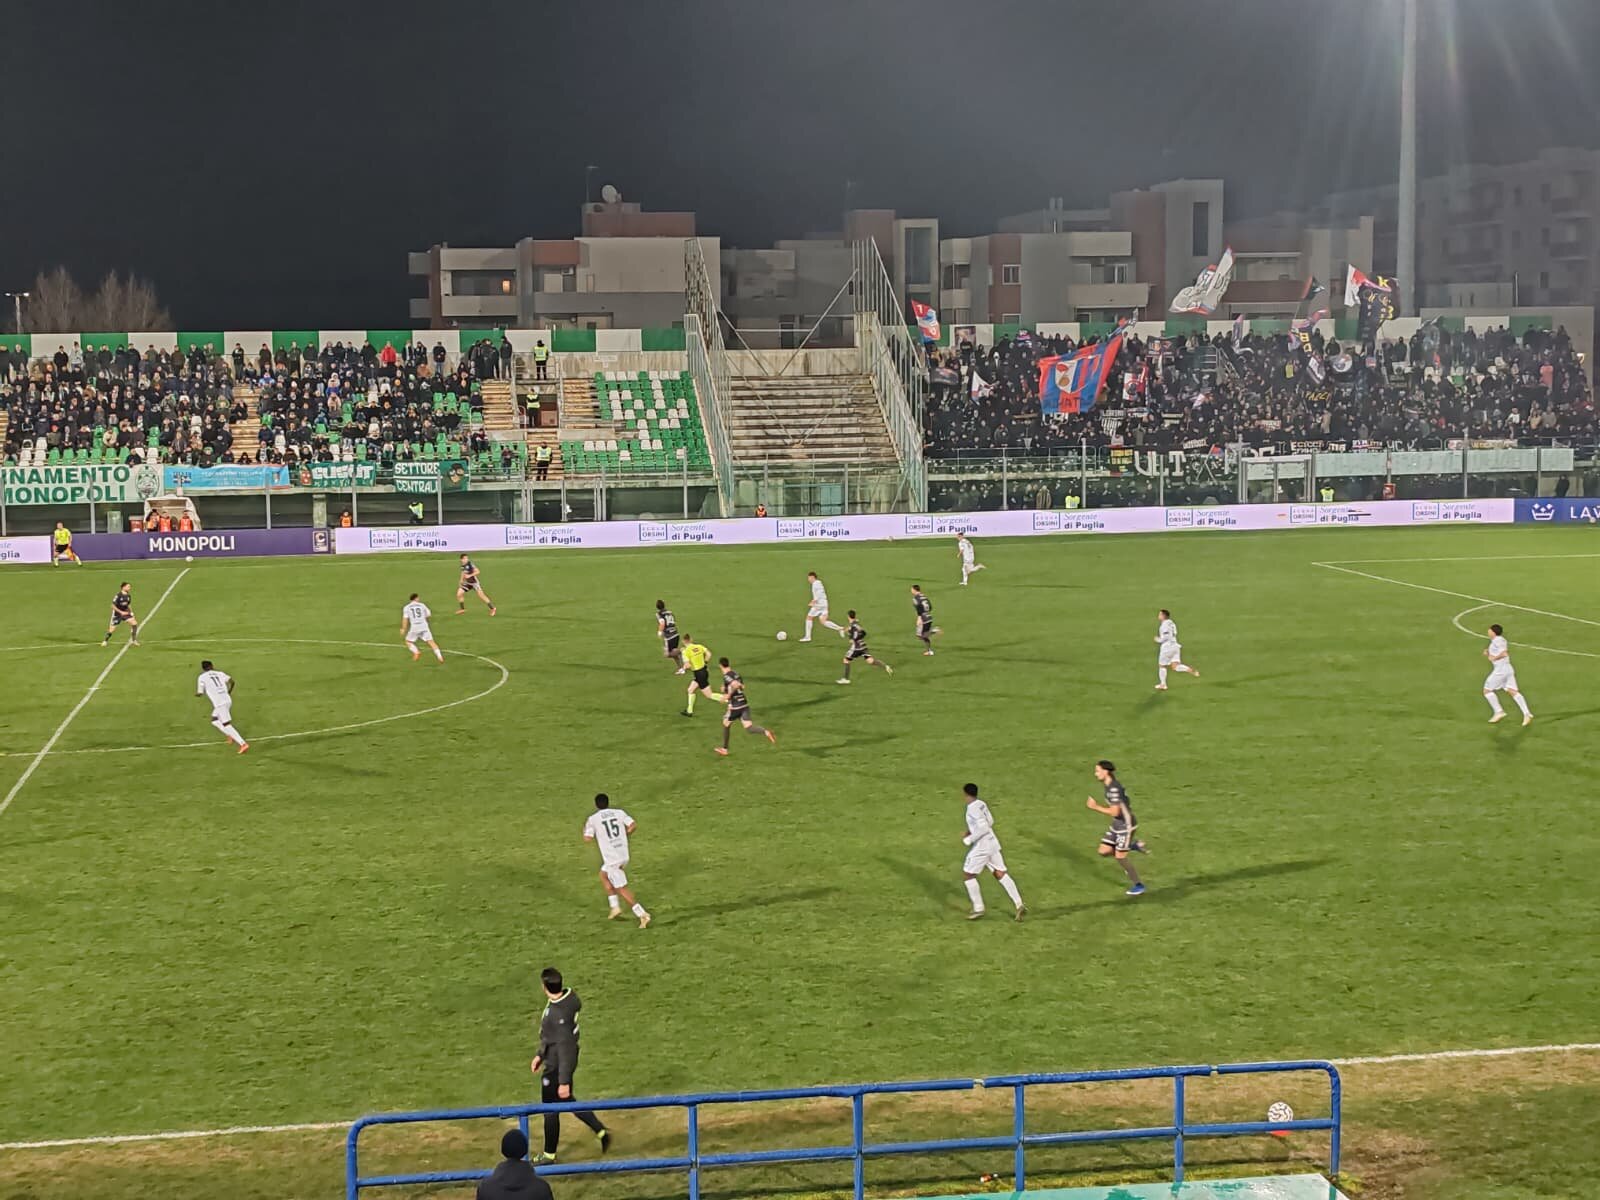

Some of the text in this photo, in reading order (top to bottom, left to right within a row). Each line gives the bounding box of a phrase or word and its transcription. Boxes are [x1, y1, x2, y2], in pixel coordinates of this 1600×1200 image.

[395, 462, 440, 475] SETTORE
[1454, 512, 1482, 520] Puglia
[1076, 522, 1104, 530] Puglia
[1209, 518, 1236, 526] Puglia
[820, 528, 850, 537] Puglia
[949, 525, 978, 533] Puglia
[552, 536, 582, 544] Puglia
[684, 532, 713, 541] Puglia
[150, 536, 235, 552] MONOPOLI
[416, 540, 447, 548] Puglia
[410, 608, 422, 618] 19
[601, 818, 620, 839] 15
